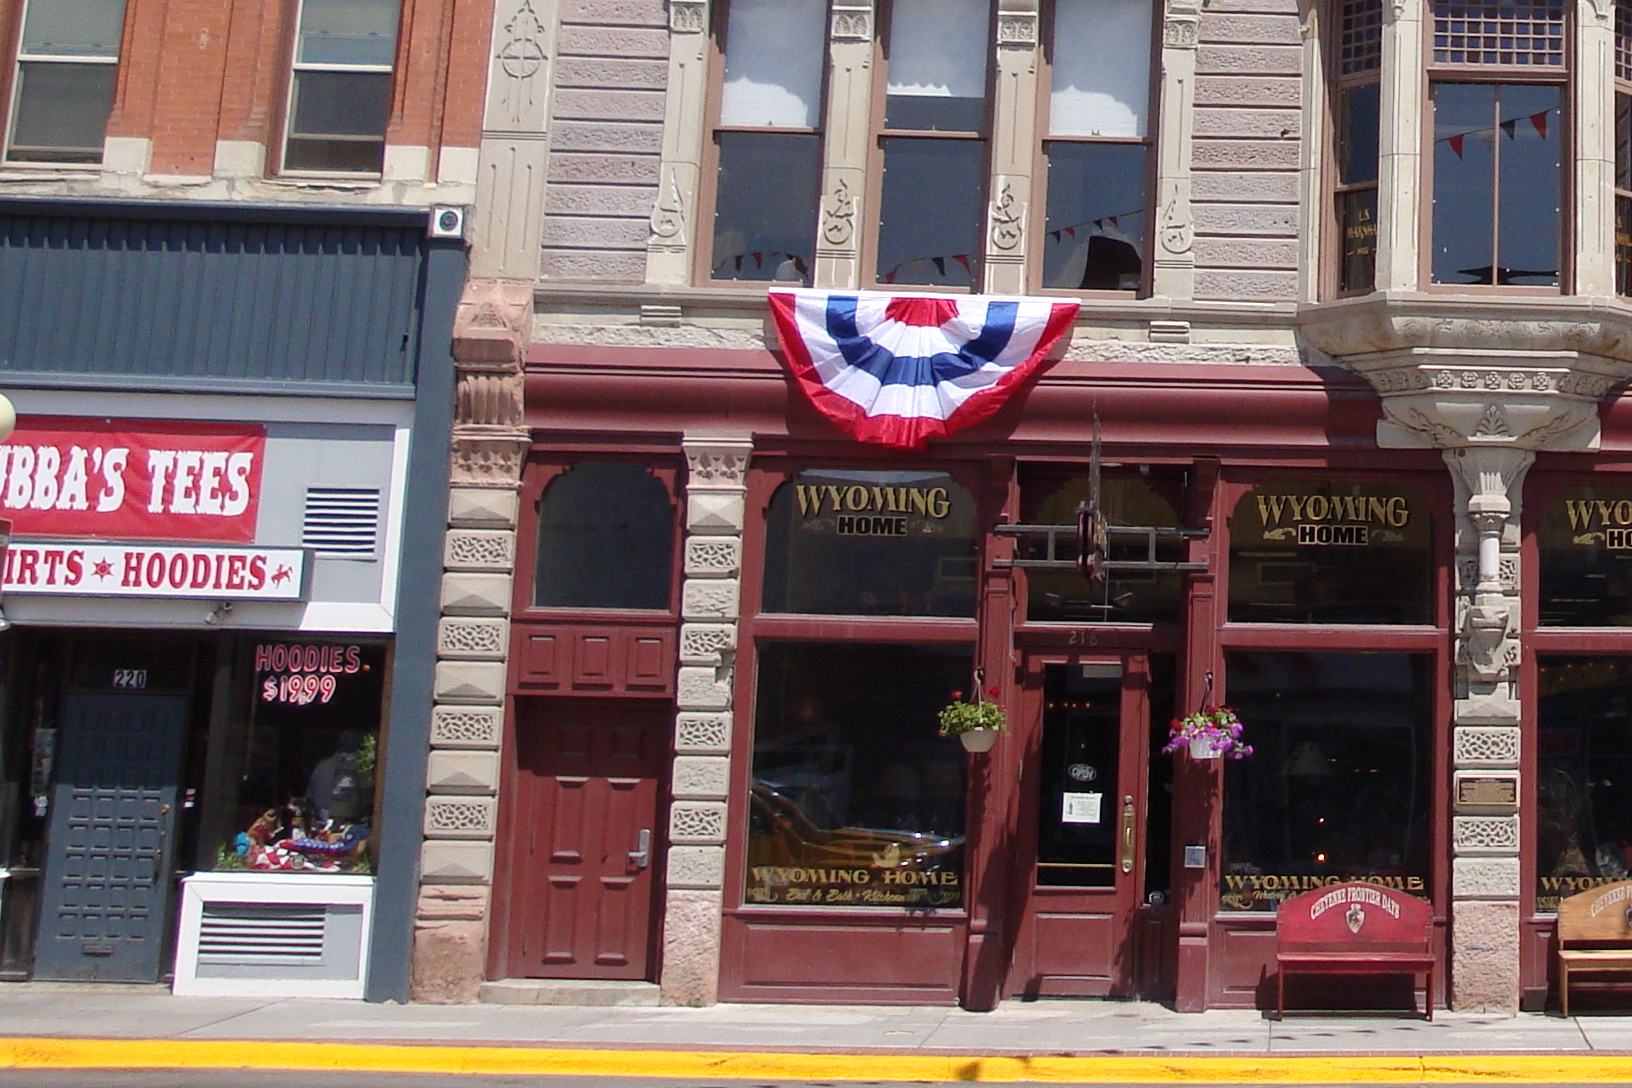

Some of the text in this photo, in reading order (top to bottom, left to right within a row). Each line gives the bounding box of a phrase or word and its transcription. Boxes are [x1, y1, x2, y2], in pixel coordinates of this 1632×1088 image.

[147, 449, 254, 516] TEES
[796, 485, 950, 518] WYOMING
[1257, 495, 1410, 527] WYOMING
[837, 515, 907, 537] HOME
[1298, 524, 1368, 545] HOME
[121, 552, 267, 590] HOODIES
[255, 644, 361, 674] HOODIES
[114, 669, 147, 688] 220
[752, 867, 959, 886] WYOMING HOME
[1225, 875, 1341, 890] WYOMING
[1310, 886, 1400, 920] CHEYENNE FRONTIER DAYS
